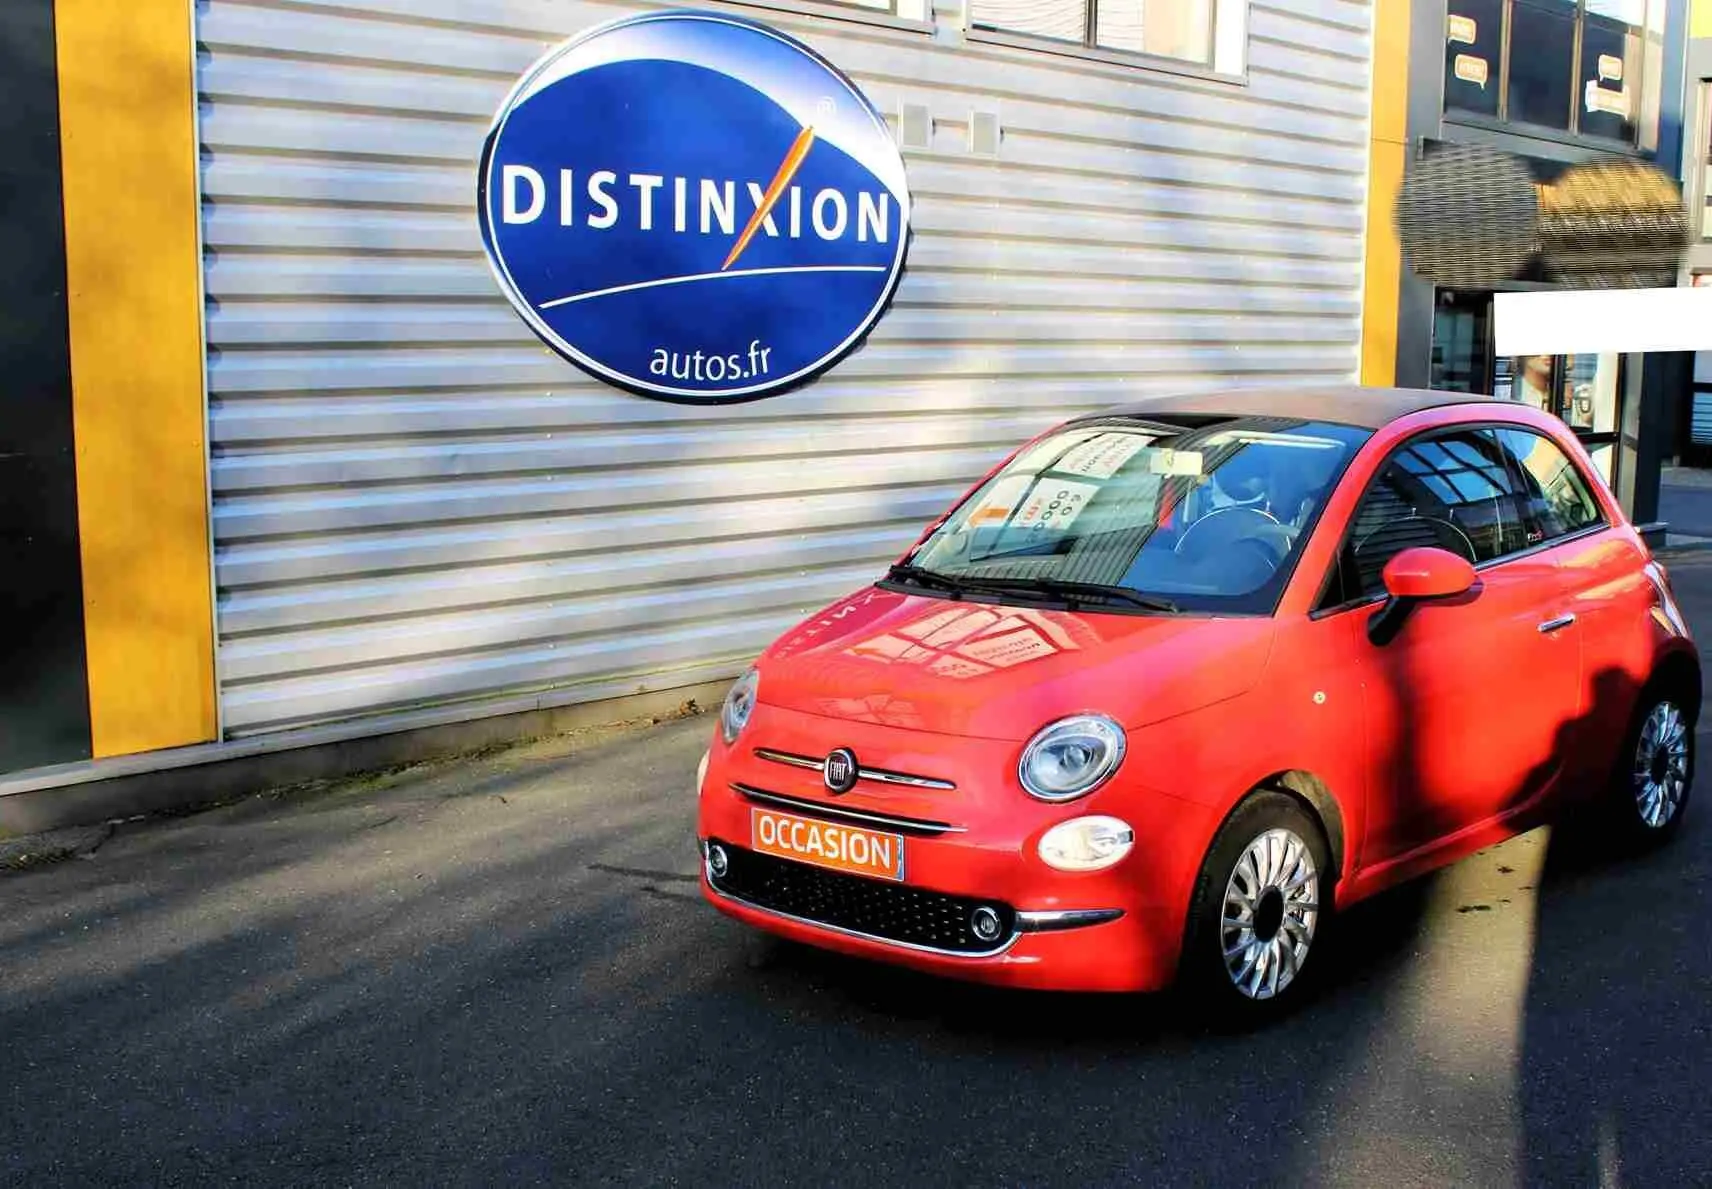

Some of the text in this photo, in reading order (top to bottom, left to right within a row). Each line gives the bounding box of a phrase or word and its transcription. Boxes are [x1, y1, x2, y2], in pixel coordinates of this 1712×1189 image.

[502, 126, 889, 270] DISTINXION
[650, 339, 772, 381] autos.fr
[829, 759, 847, 781] FIAT
[759, 815, 891, 869] OCCASION
